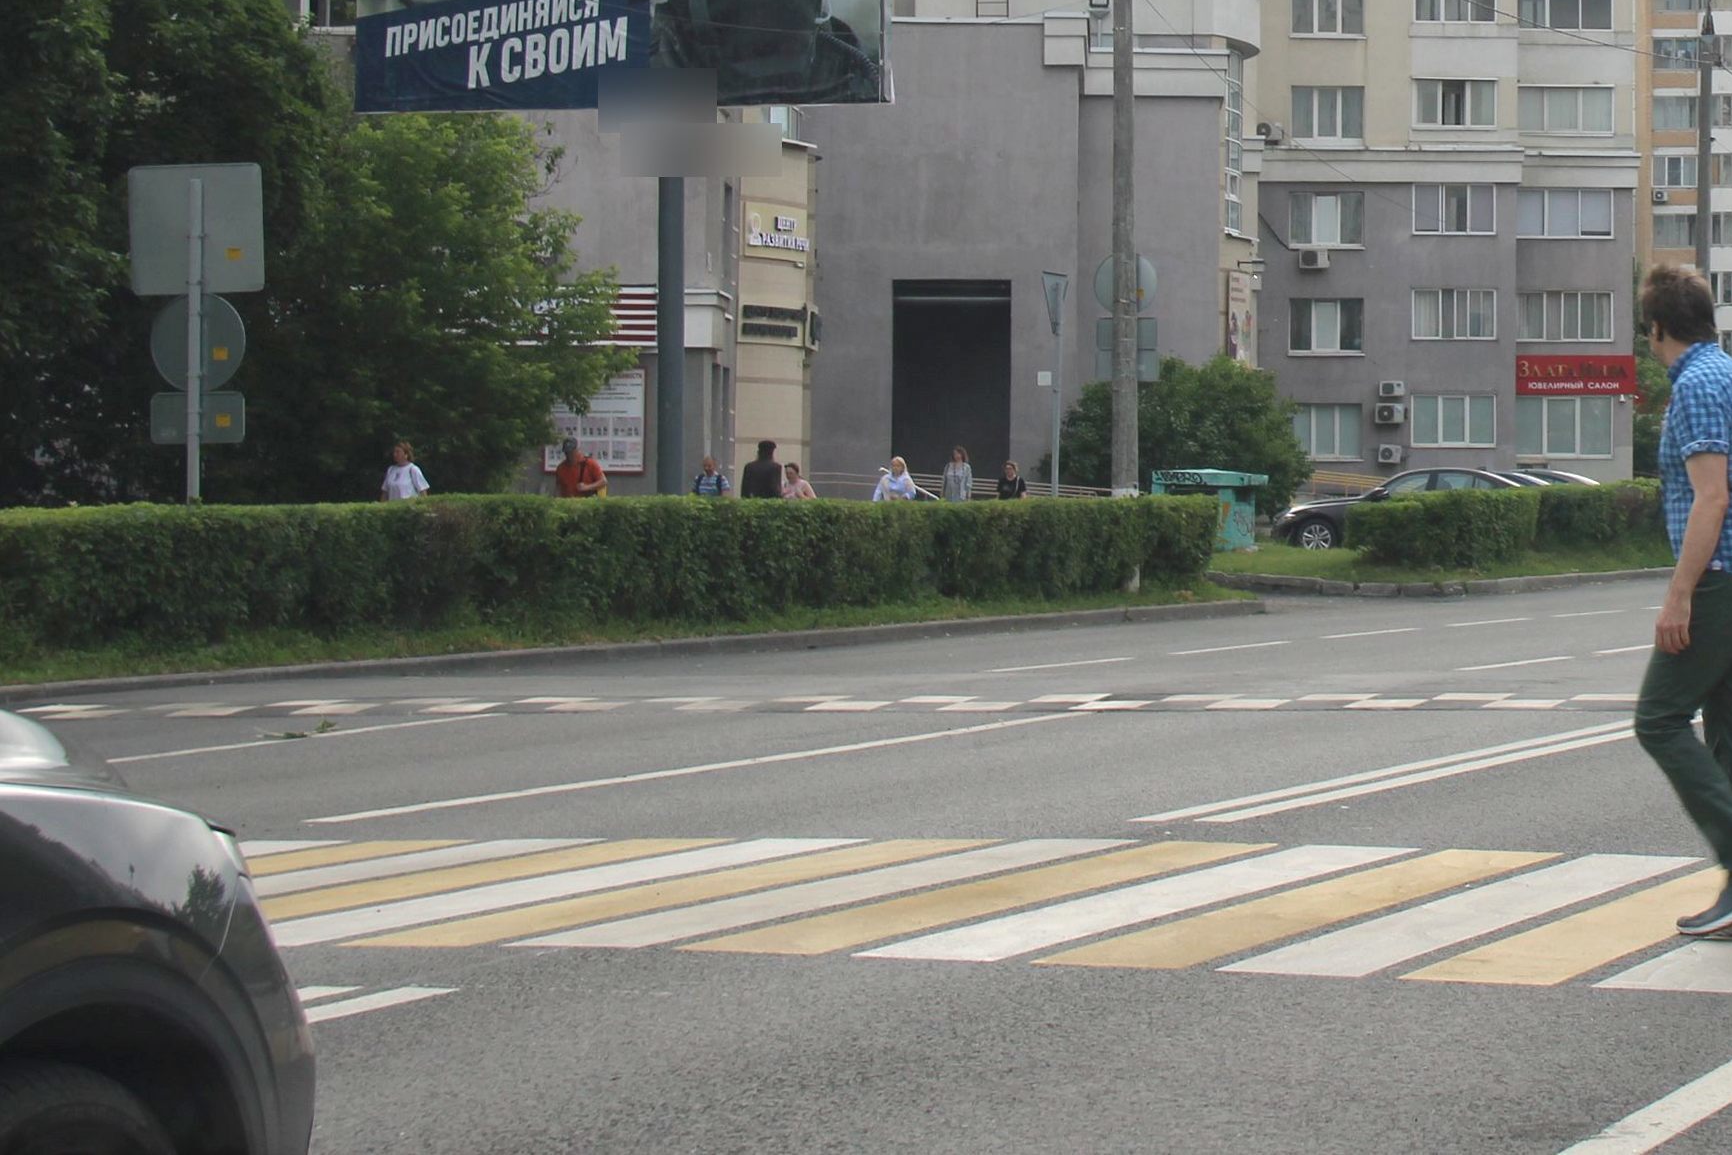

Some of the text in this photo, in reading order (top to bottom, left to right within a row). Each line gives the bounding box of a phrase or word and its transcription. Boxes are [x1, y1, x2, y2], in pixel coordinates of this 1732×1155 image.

[467, 16, 628, 89] К СВОИМ
[1528, 381, 1584, 390] ЮВЕЛИРНЫЙ
